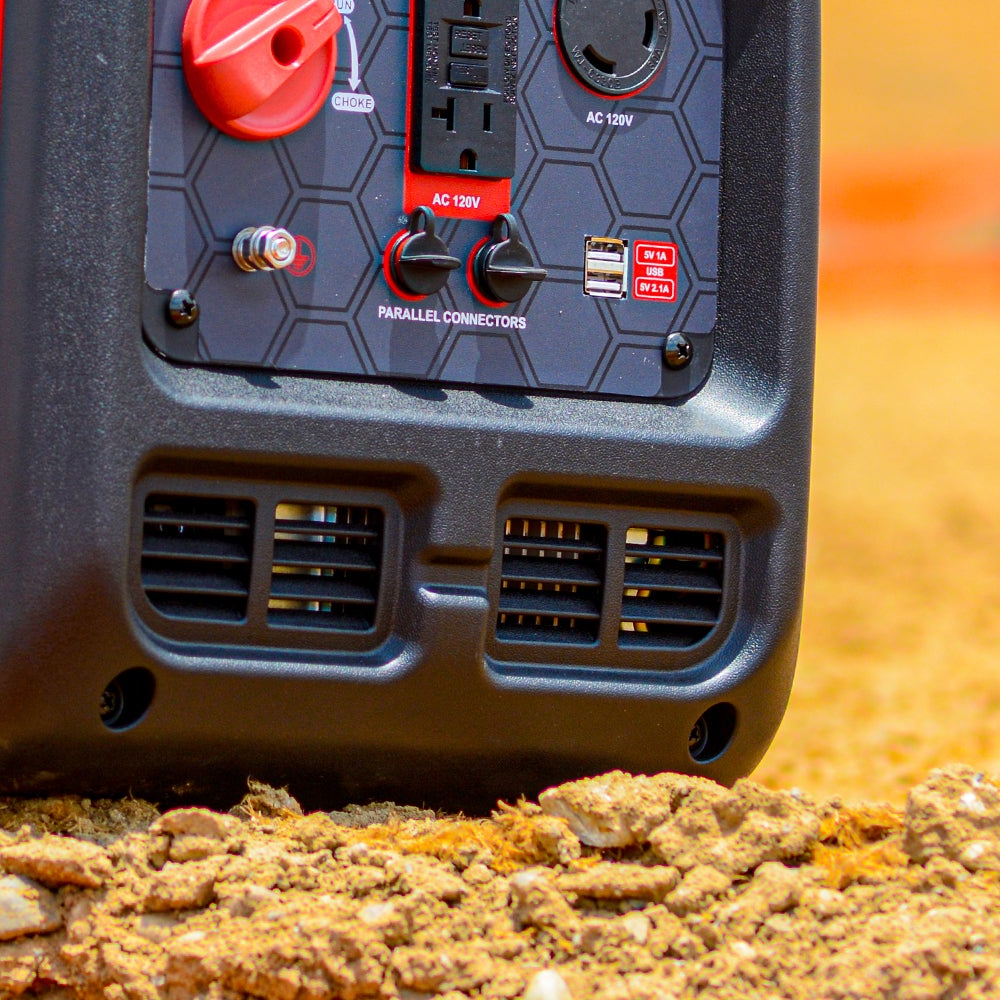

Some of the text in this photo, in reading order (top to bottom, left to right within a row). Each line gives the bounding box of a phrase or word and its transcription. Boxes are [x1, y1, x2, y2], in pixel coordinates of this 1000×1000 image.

[334, 0, 352, 10] UN
[334, 96, 372, 109] CHOKE
[586, 111, 634, 127] AC 120V
[432, 193, 480, 209] AC 120V
[644, 250, 667, 261] 5V 1A
[646, 266, 664, 277] USB
[639, 282, 670, 293] 5V 2.1A
[378, 305, 527, 329] PARALLEL CONNECTORS
